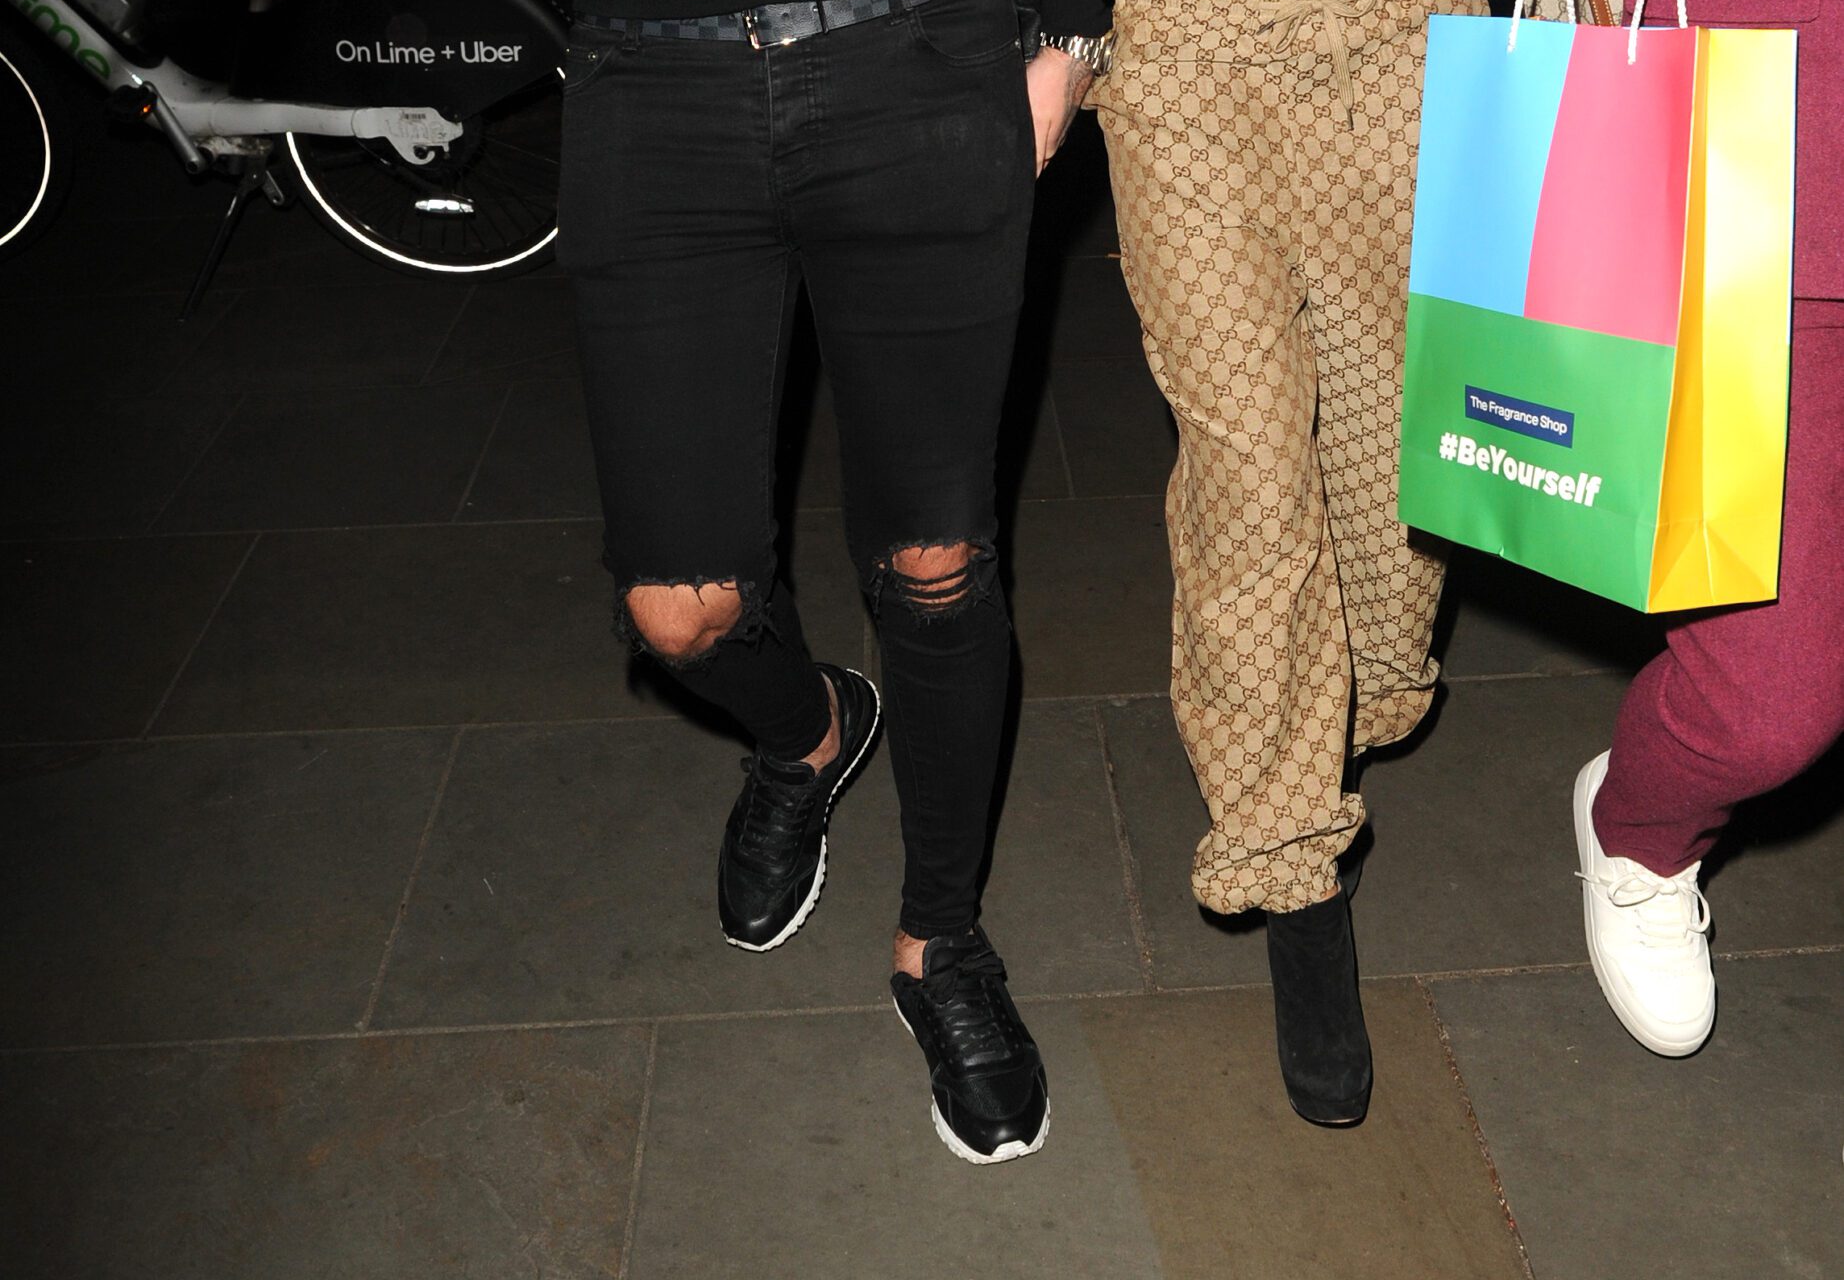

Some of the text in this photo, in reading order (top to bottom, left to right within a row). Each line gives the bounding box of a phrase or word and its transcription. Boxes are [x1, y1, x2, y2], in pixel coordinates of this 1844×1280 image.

[336, 40, 371, 62] On
[376, 41, 435, 63] Lime
[460, 40, 522, 62] Uber
[1470, 395, 1567, 435] The Fragrance Shop
[1439, 432, 1602, 507] #BeYourself
